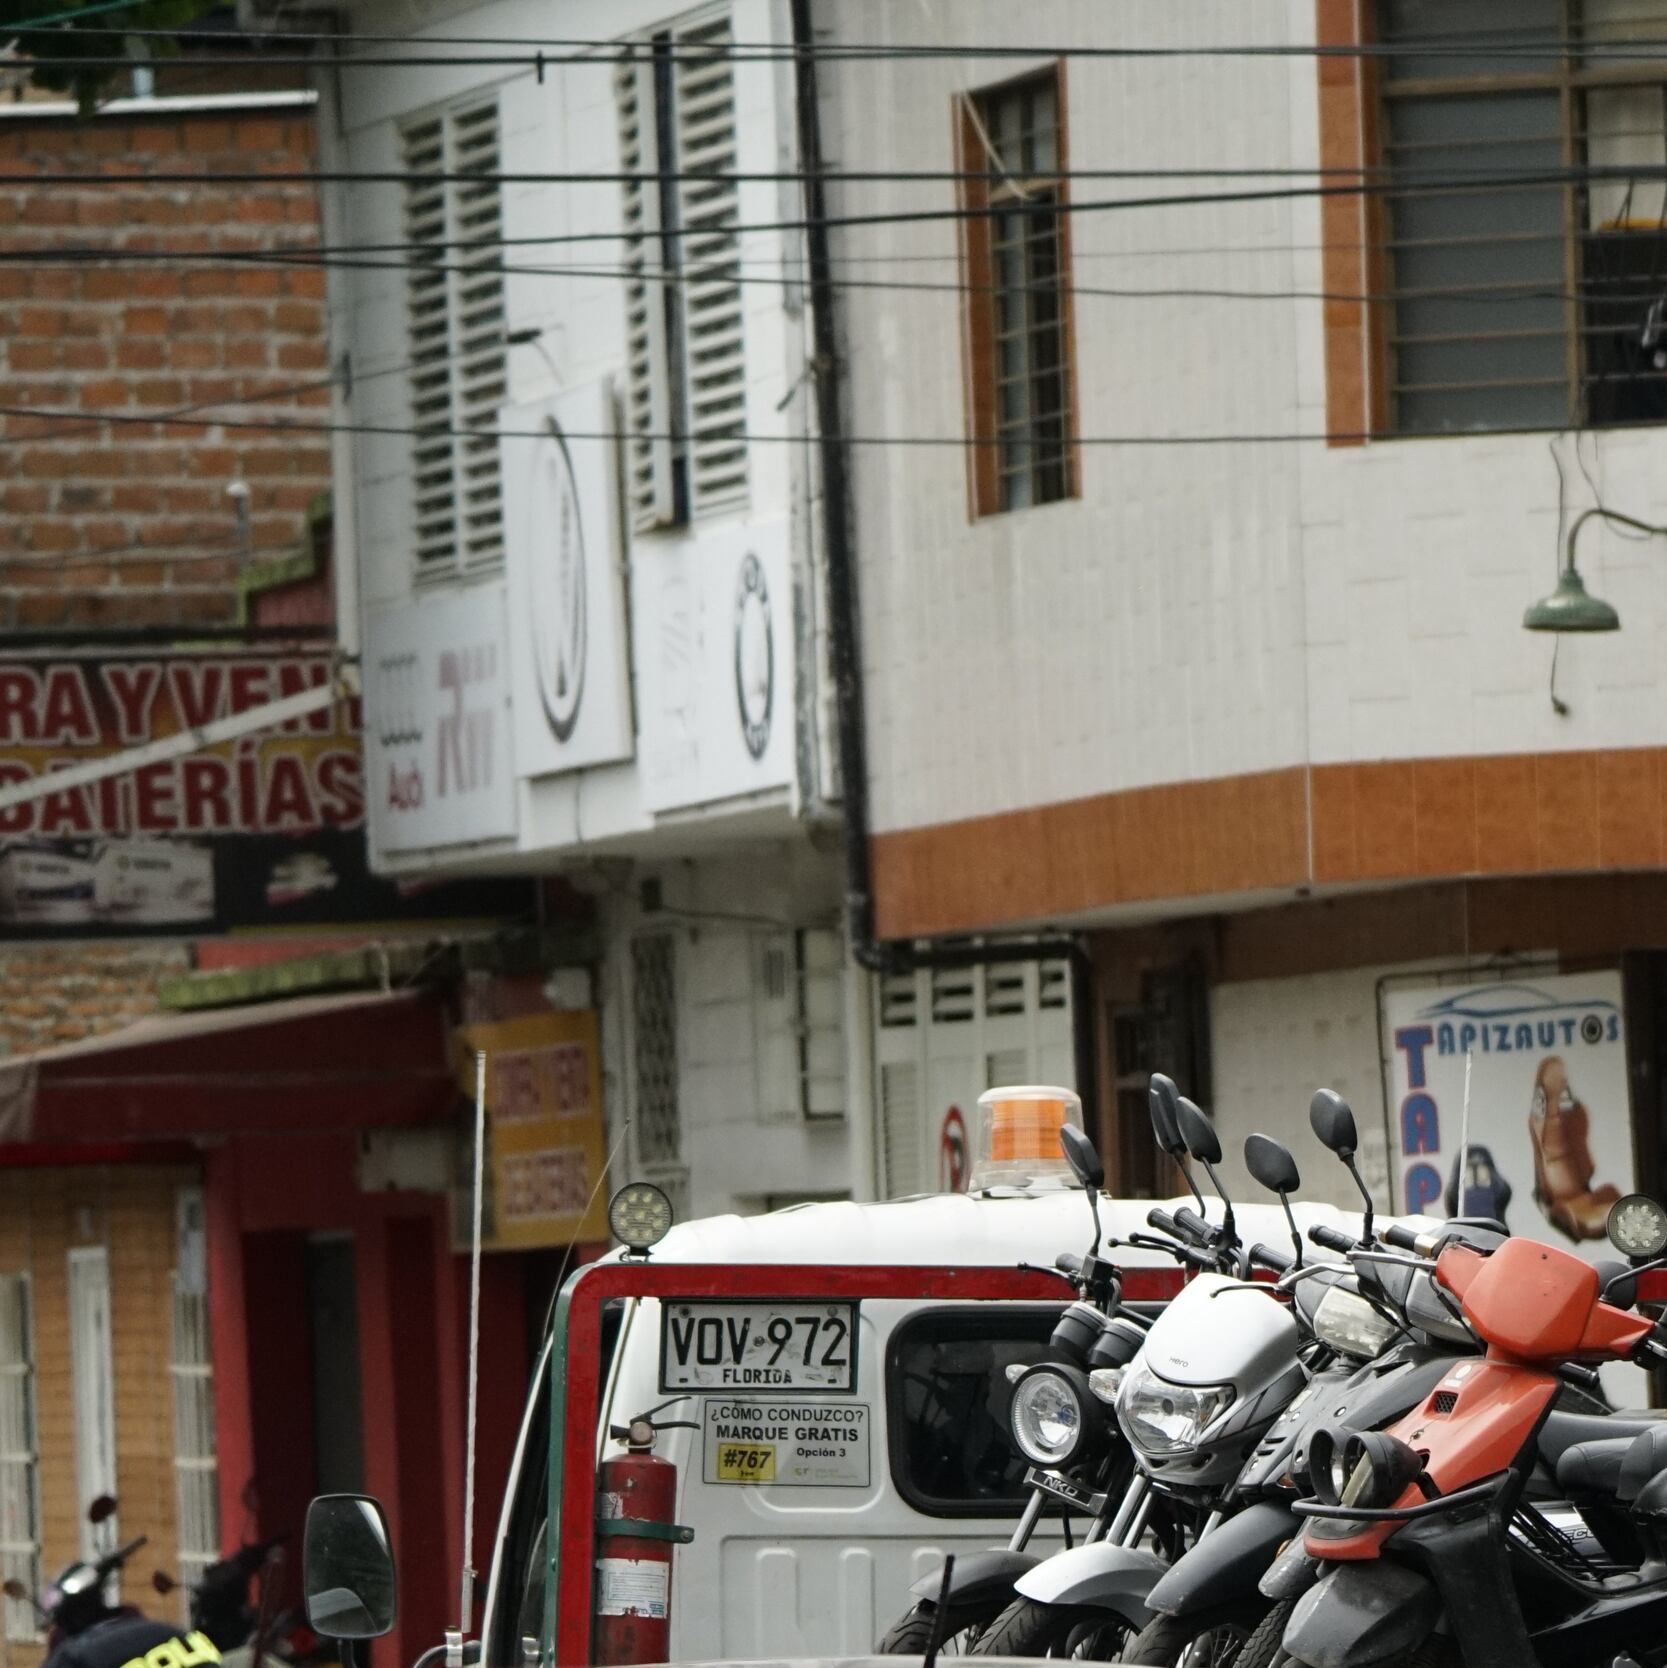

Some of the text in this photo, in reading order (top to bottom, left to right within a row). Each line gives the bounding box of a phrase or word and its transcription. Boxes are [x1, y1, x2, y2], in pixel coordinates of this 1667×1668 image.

[108, 666, 160, 738] Y
[172, 662, 362, 732] VEN
[671, 1317, 848, 1366] VOV 972
[722, 1368, 793, 1384] FLORIDA
[768, 1408, 864, 1423] CONDUZCO?
[716, 1425, 859, 1442] MARQUE GRATIS
[723, 1449, 772, 1469] #767
[797, 1447, 846, 1459] Opción 3
[1043, 1475, 1079, 1498] NKD
